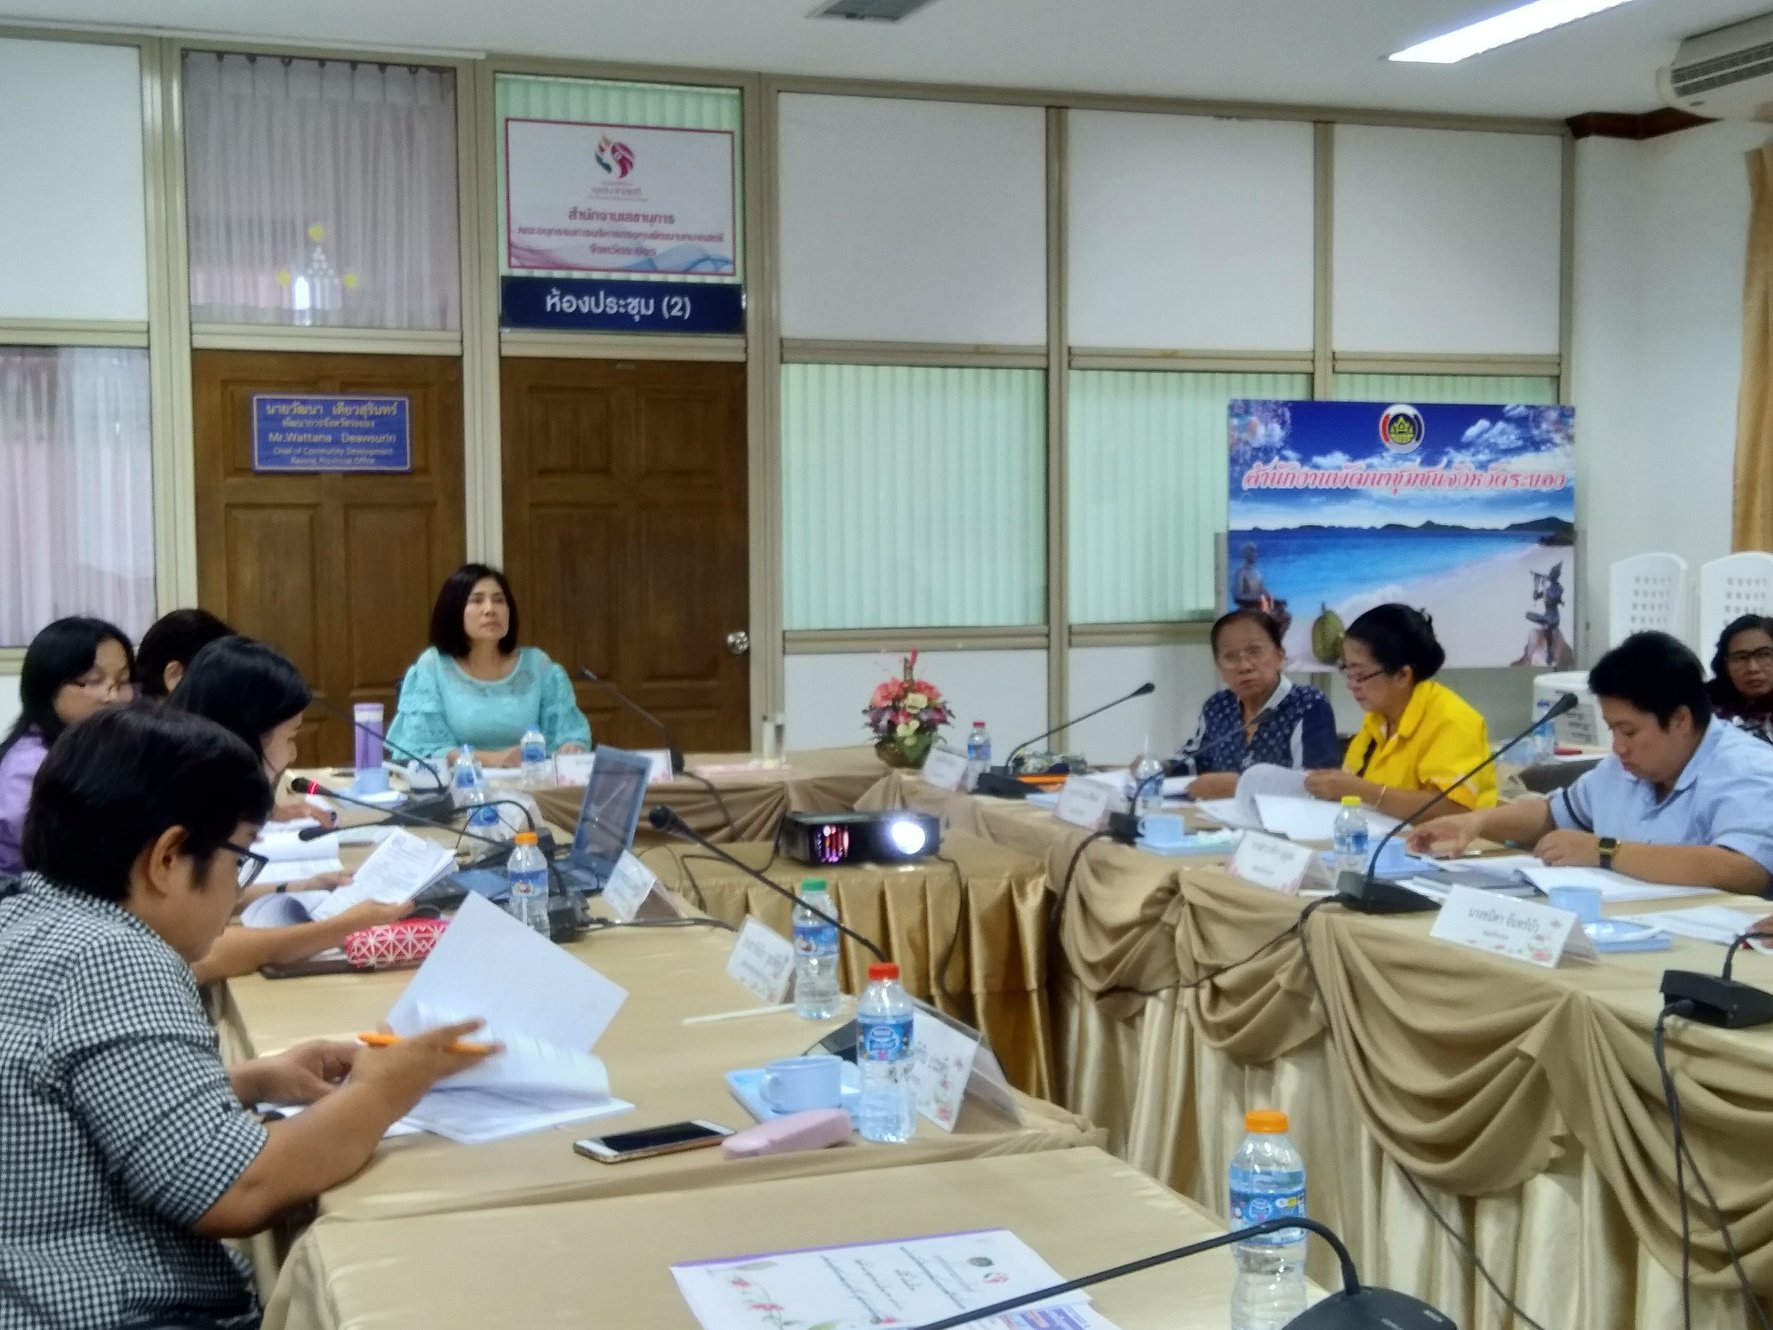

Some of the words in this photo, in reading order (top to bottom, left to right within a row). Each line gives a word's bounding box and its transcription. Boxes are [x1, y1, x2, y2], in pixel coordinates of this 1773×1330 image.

[546, 287, 655, 322] ห้องประชุม
[661, 295, 692, 320] (2)
[1243, 457, 1566, 495] สำนักงานพัฒนาชุมชนจังหวัดระยอง
